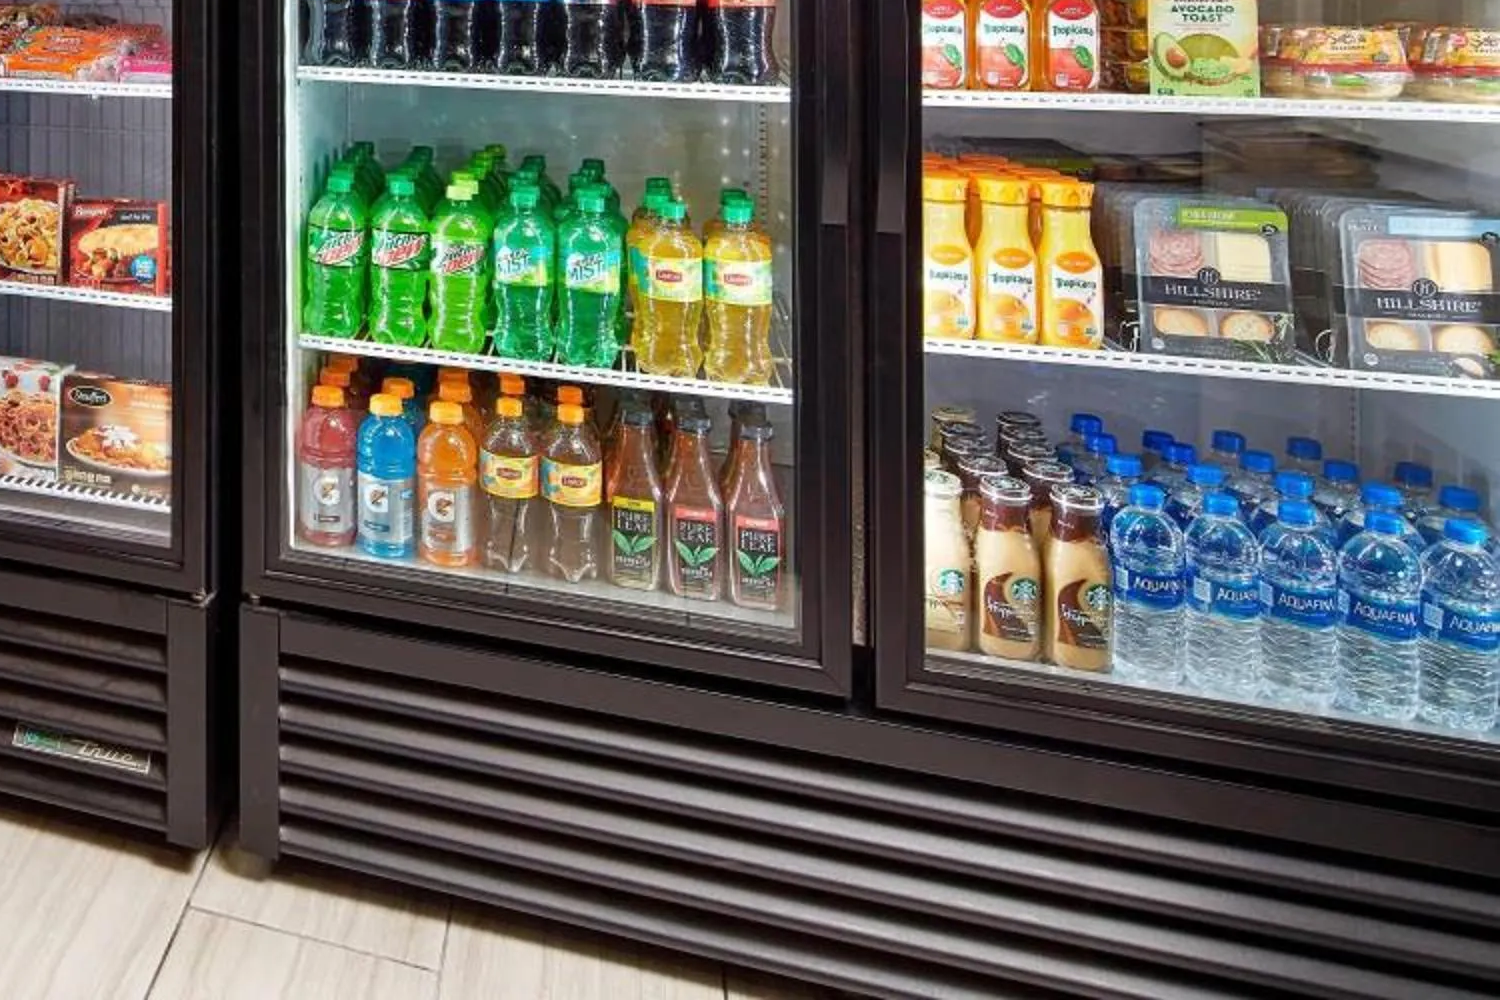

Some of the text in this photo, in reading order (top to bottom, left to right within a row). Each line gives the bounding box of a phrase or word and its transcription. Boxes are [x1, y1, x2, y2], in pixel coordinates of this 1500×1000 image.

[1171, 4, 1235, 13] AVOCADO
[1181, 13, 1224, 23] TOAST
[1052, 24, 1094, 37] Tropicana
[1164, 284, 1257, 302] HILLSHIRE
[1376, 297, 1479, 314] HILLSHIRE
[1132, 575, 1186, 594] AQUAFIN
